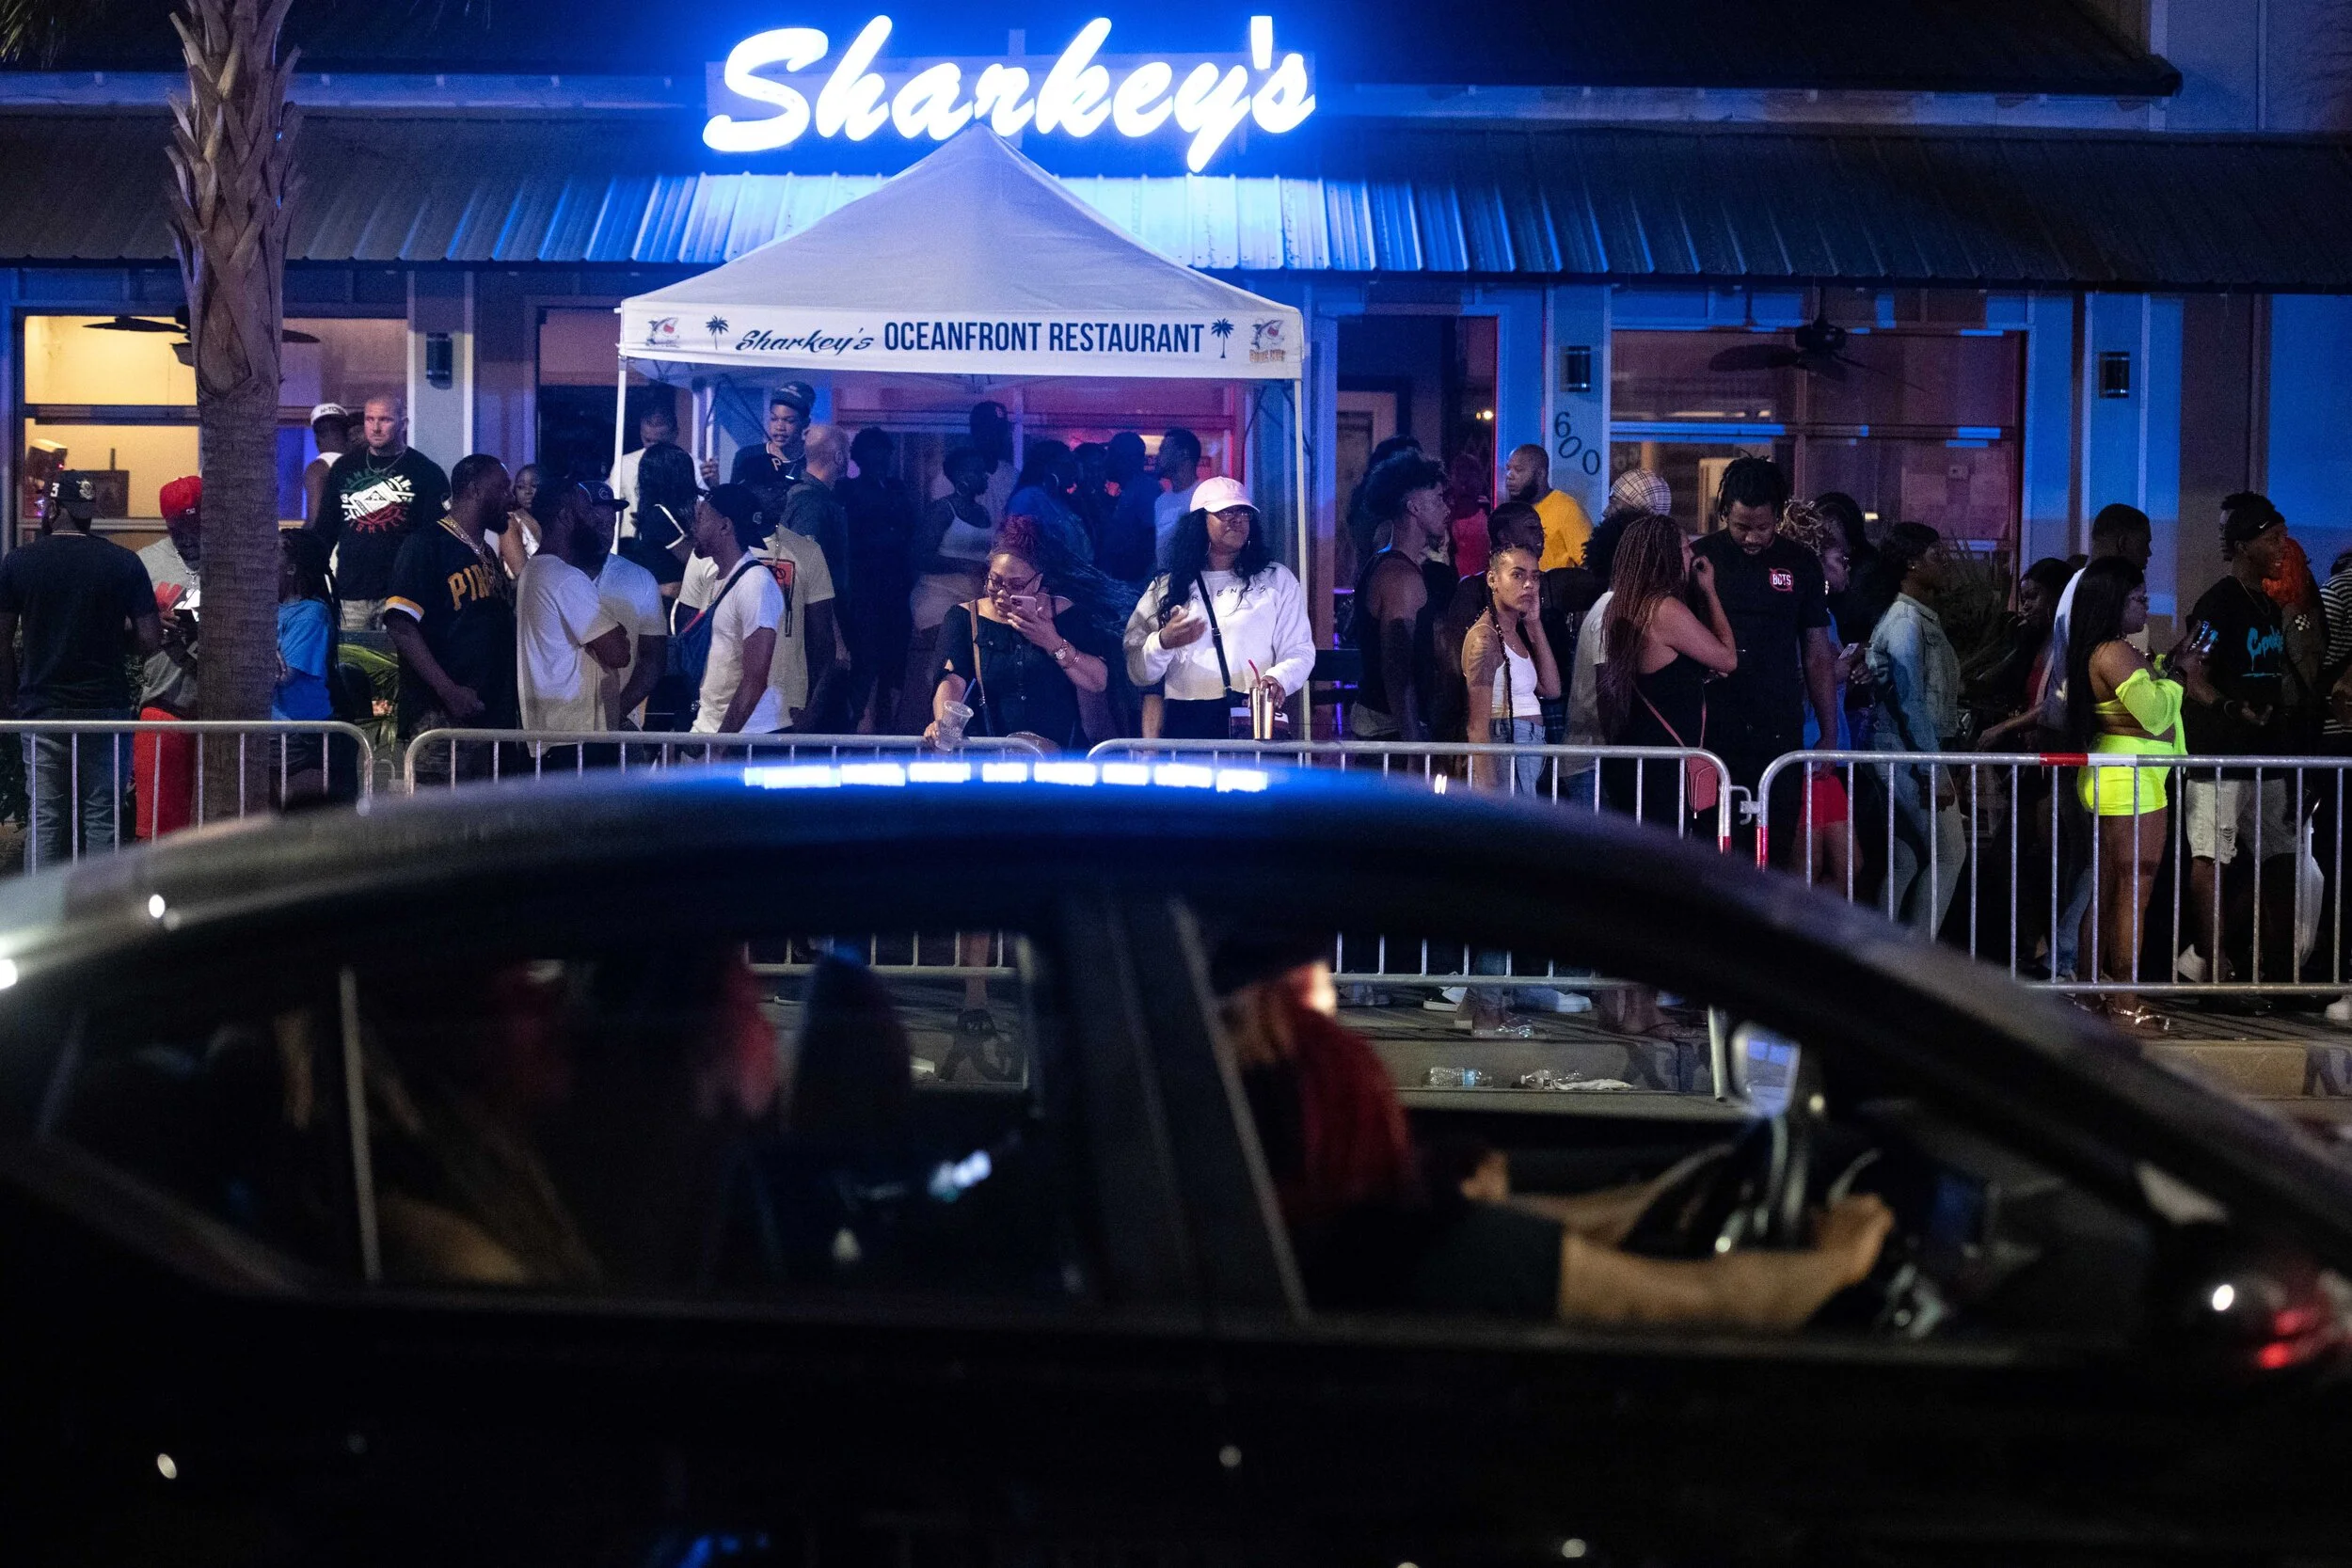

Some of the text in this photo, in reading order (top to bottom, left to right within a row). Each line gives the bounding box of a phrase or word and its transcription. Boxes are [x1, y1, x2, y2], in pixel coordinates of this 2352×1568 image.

[703, 15, 1316, 173] Sharkey's
[736, 322, 1204, 356] Sharkey's OCEANFRONT RESTAURANT
[1554, 412, 1600, 475] 600
